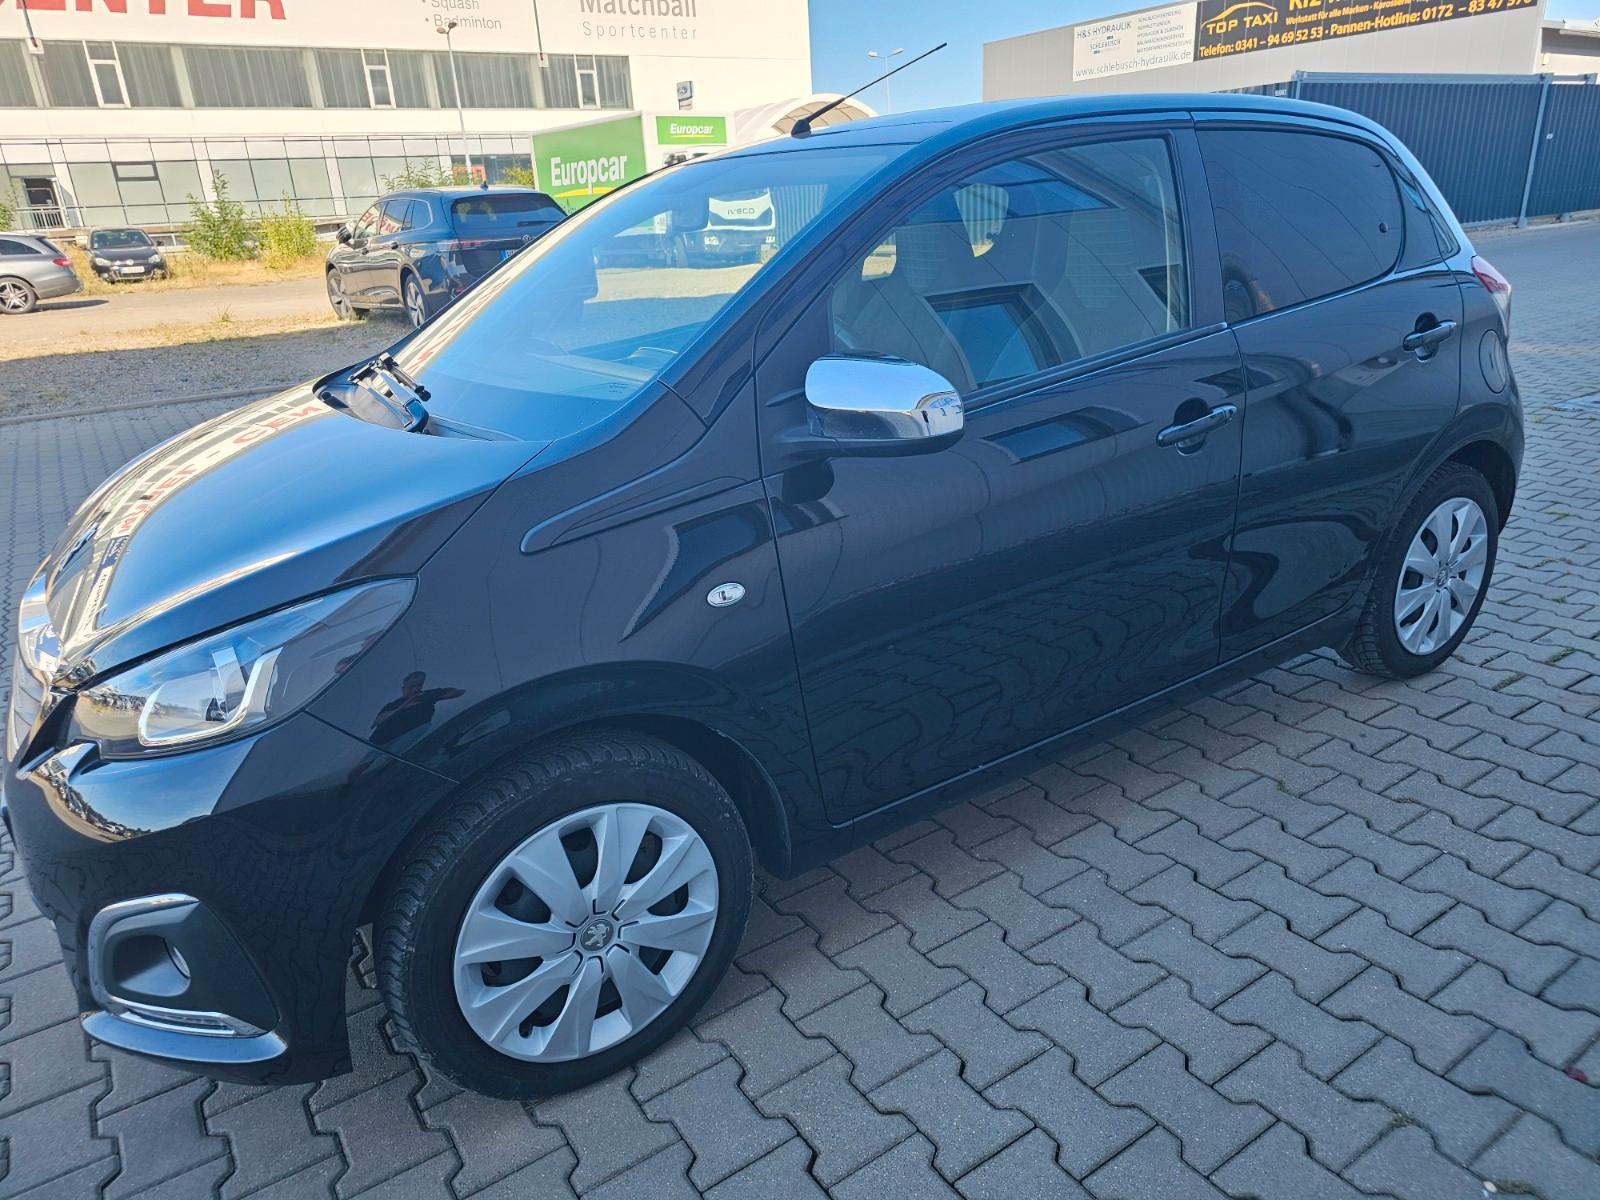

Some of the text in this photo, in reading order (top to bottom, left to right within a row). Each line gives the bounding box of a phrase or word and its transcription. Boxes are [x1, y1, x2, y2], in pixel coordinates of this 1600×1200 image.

[582, 21, 696, 40] Sportcenter
[1200, 43, 1234, 57] Telefon:
[1235, 38, 1258, 51] 0341
[1267, 34, 1280, 46] 94
[1281, 31, 1294, 43] 69
[1330, 12, 1420, 35] Pannen-Hotline:
[1422, 4, 1454, 20] 0172
[1206, 11, 1278, 35] TOP TAXI
[670, 123, 714, 136] Europcar
[550, 155, 628, 194] Europcar
